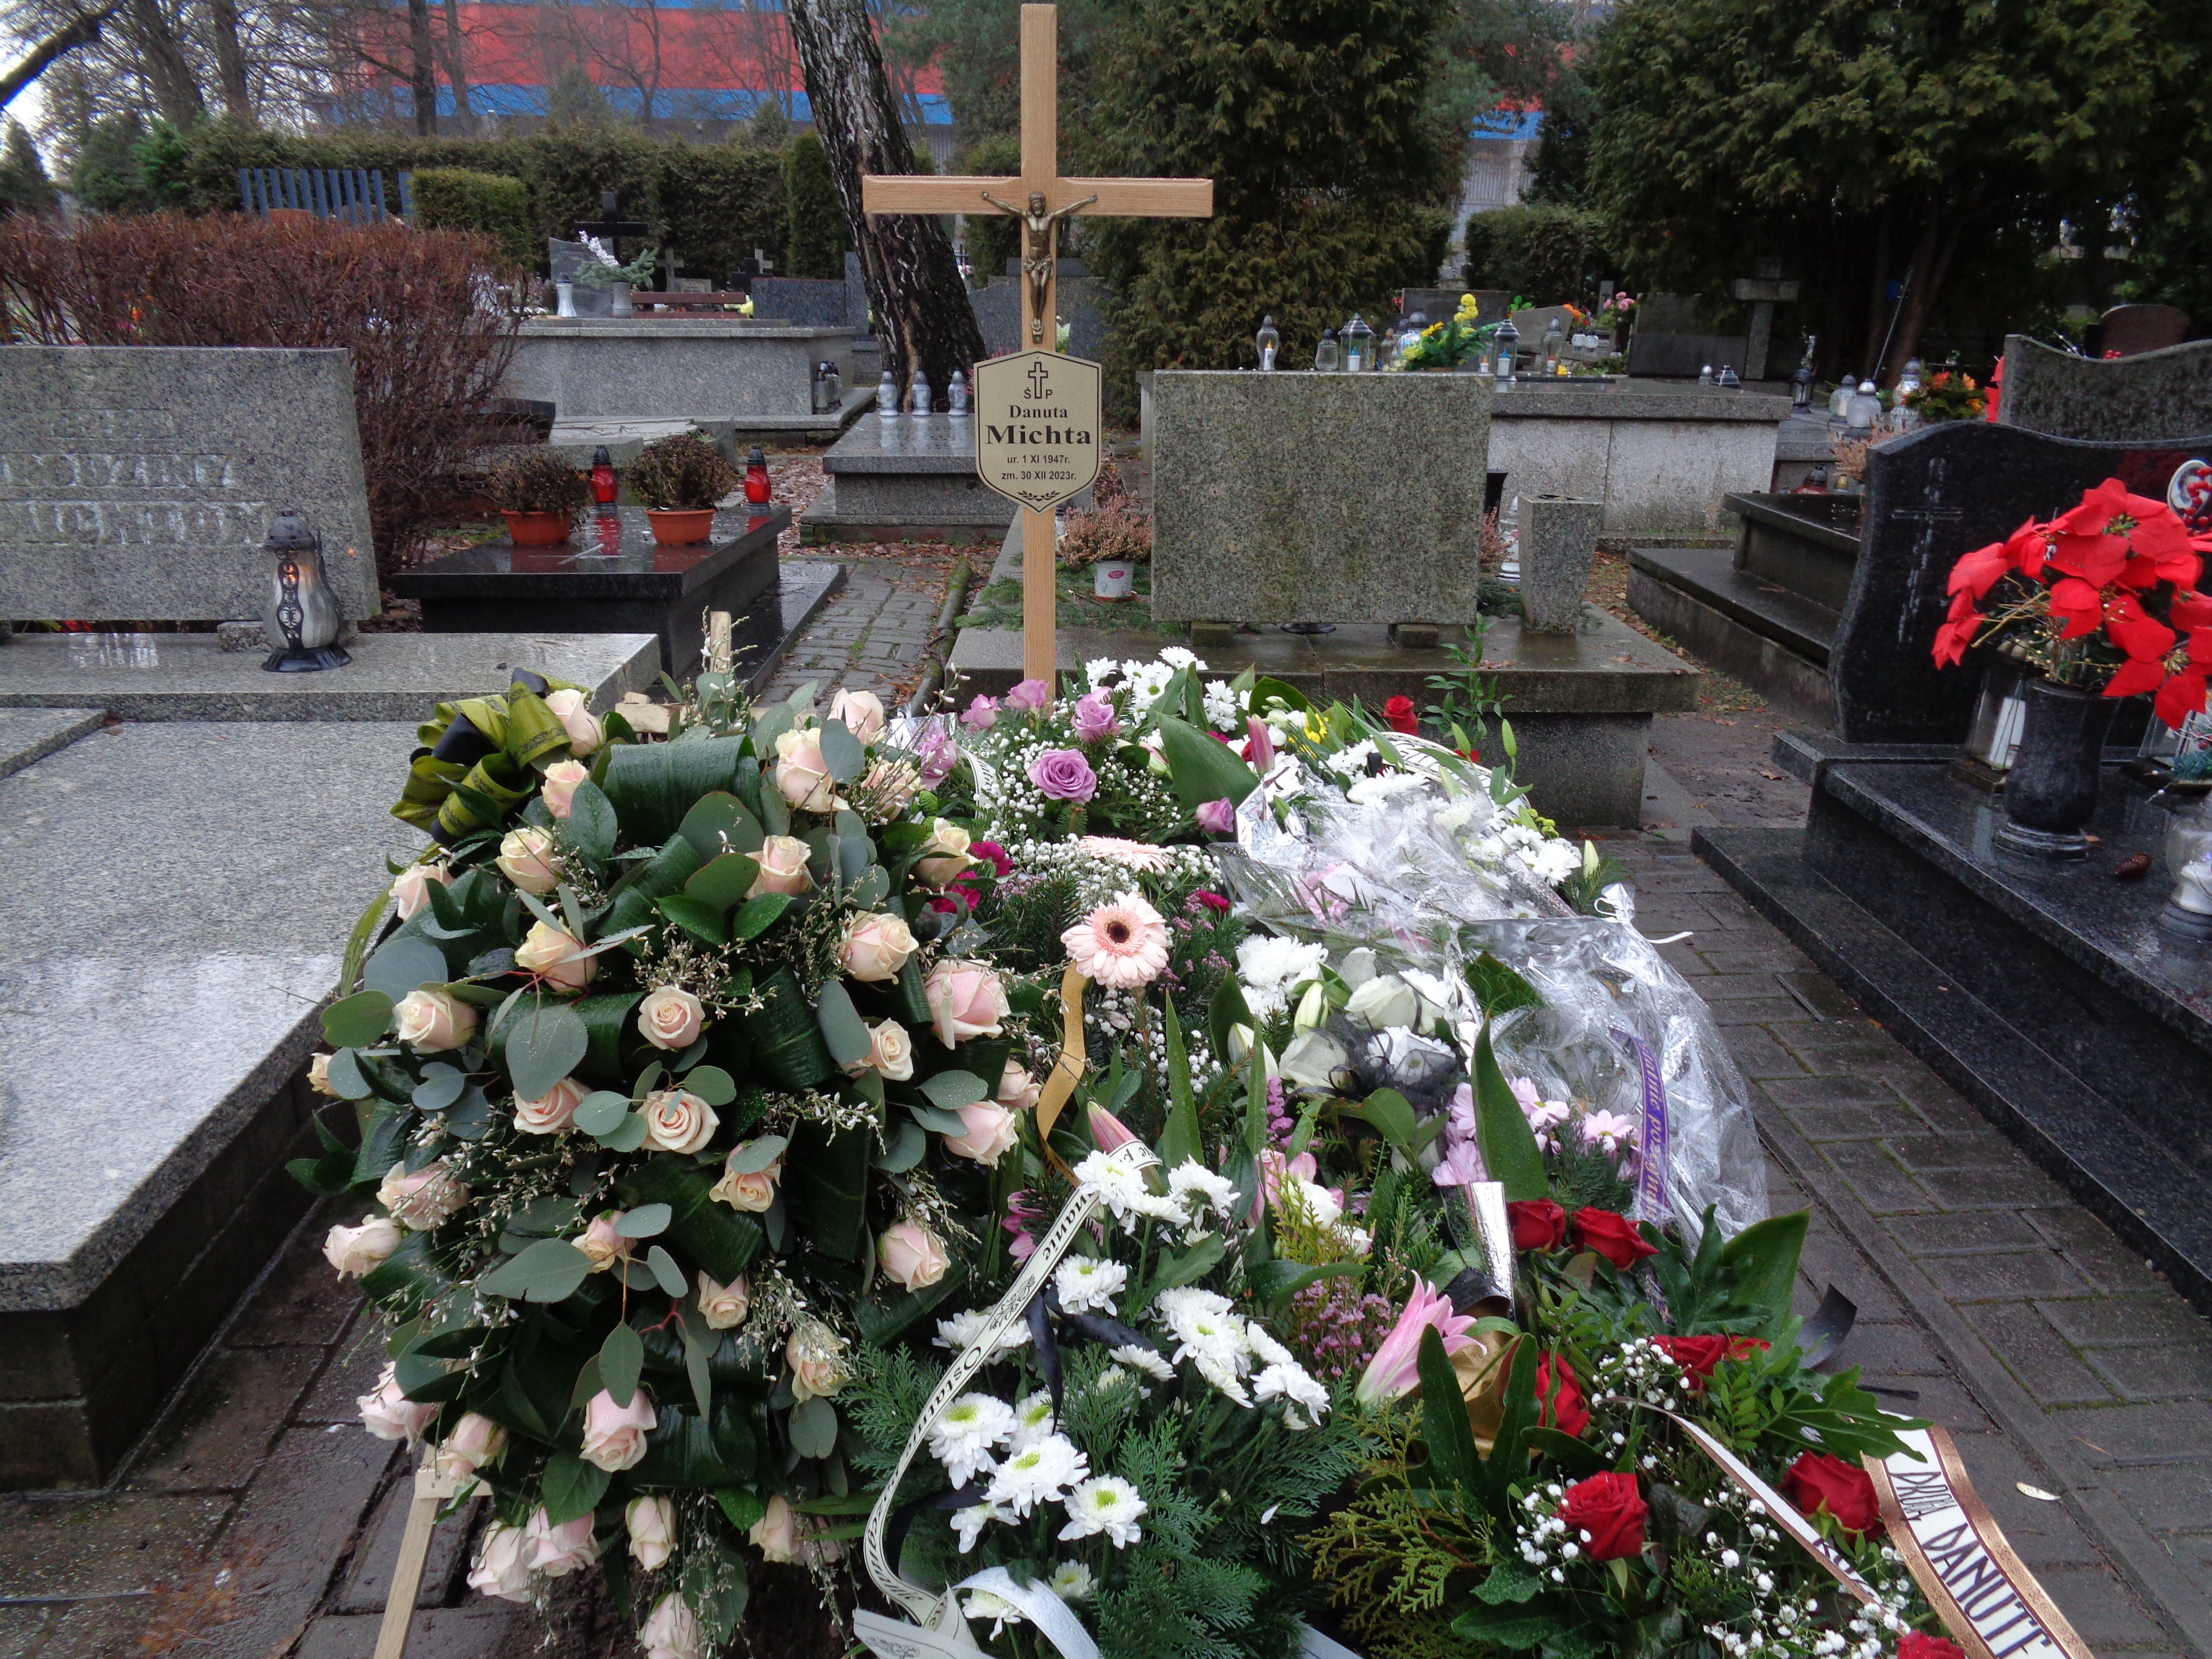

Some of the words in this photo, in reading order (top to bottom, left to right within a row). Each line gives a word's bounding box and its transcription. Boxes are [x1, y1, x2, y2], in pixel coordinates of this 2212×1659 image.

[1024, 387, 1031, 399] Ś
[1045, 389, 1052, 399] P
[1009, 405, 1068, 418] Danuta
[985, 425, 1092, 444] Michta
[1022, 455, 1027, 463] 1
[1030, 455, 1039, 463] XI
[1043, 455, 1070, 464] 1947r.
[1021, 471, 1031, 480] 30
[1034, 471, 1046, 480] XII
[1049, 471, 1076, 480] 2023r.
